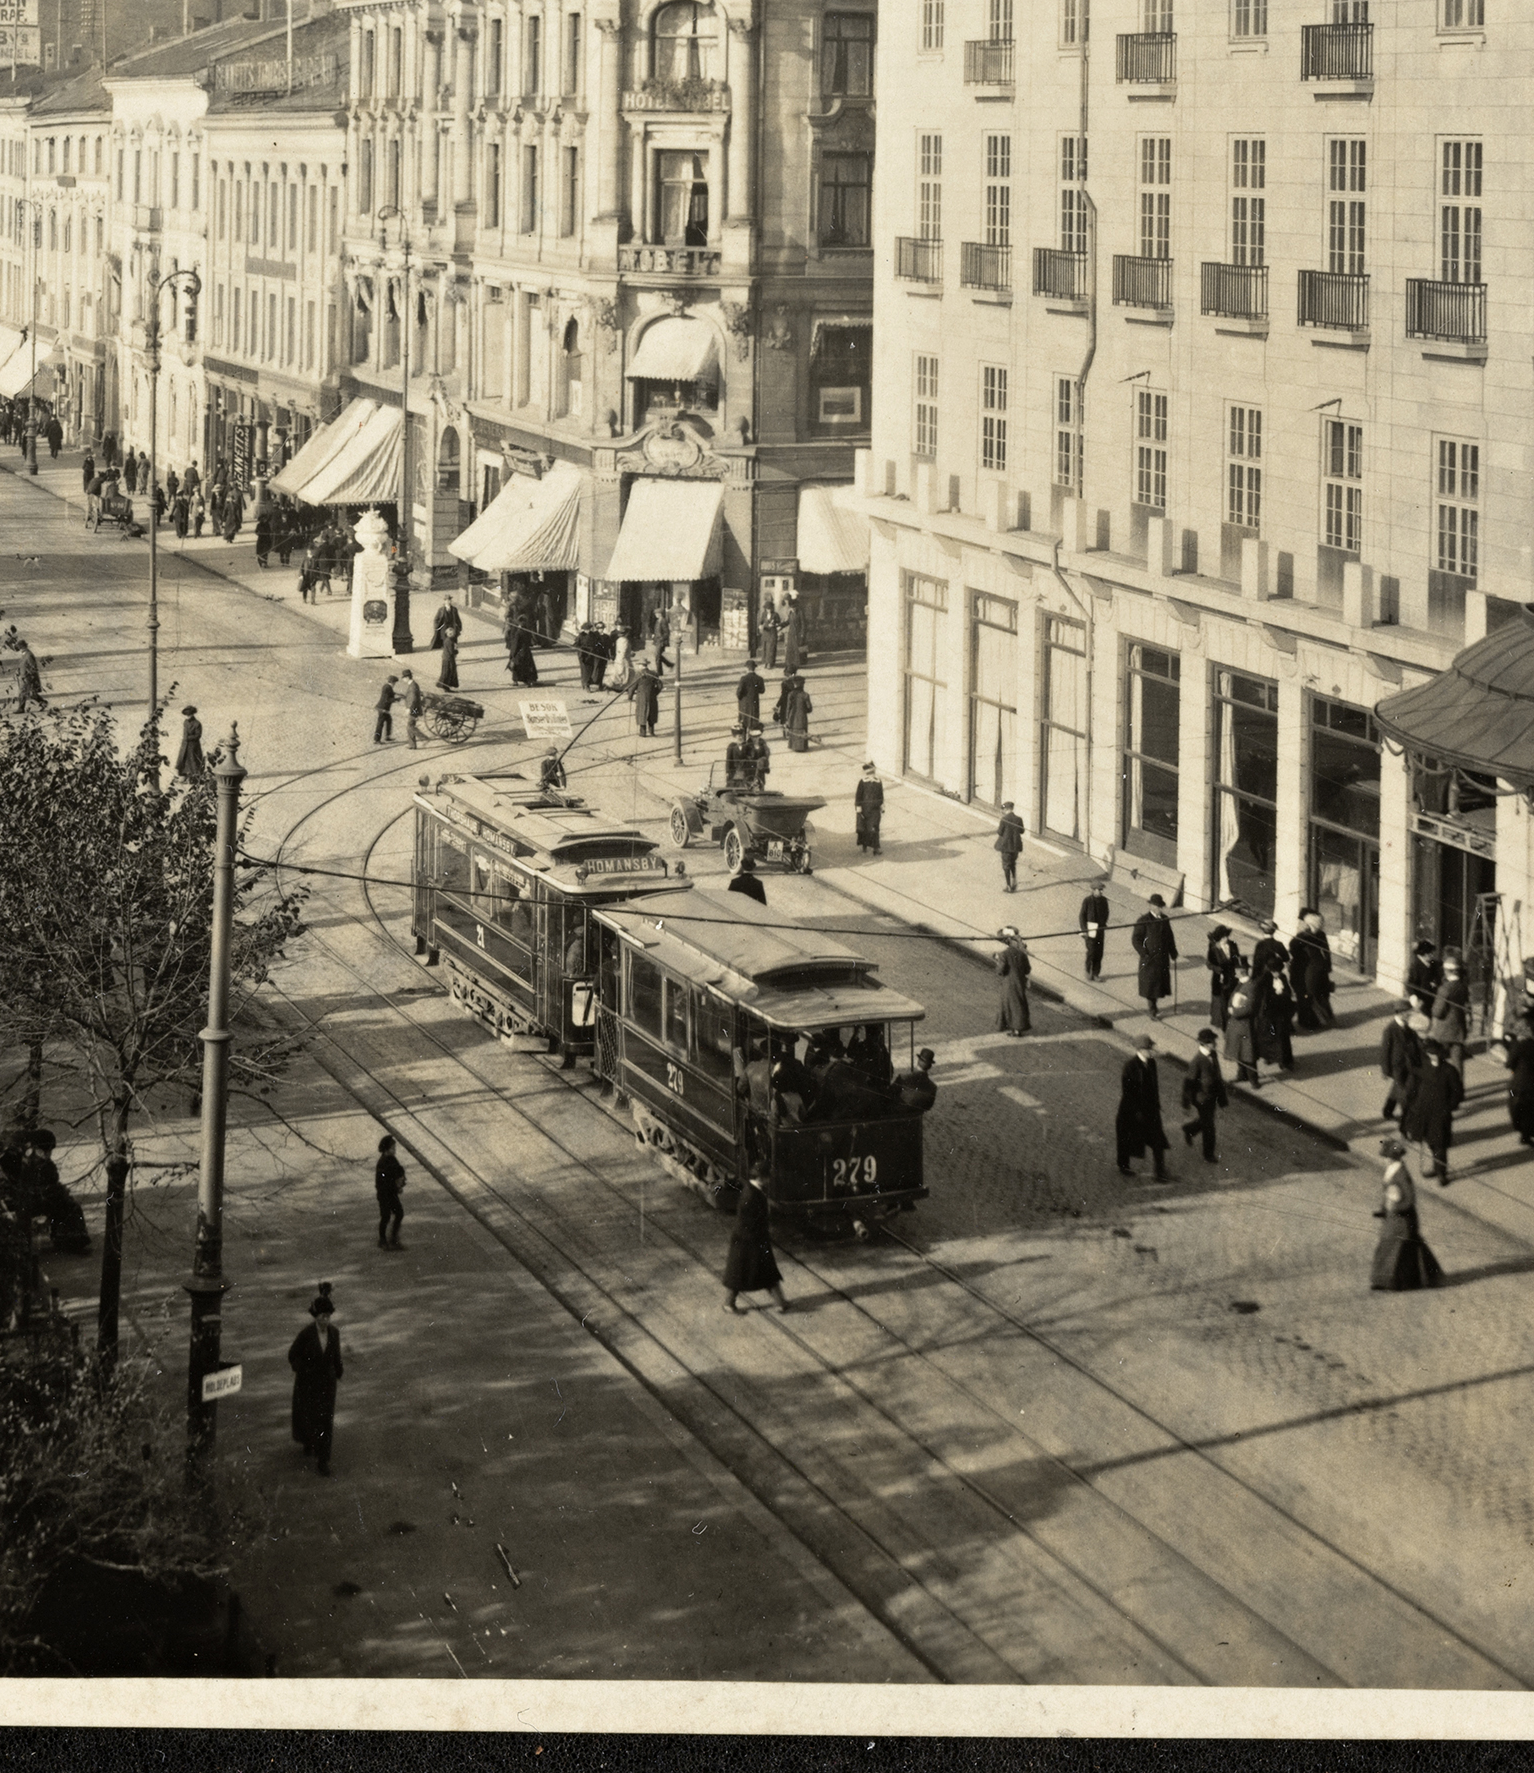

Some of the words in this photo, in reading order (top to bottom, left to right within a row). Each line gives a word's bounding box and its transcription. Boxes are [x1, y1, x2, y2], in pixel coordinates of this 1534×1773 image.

[587, 856, 657, 873] HOMANSBY
[476, 924, 485, 948] 21
[667, 1062, 684, 1095] 279
[832, 1155, 877, 1186] 279
